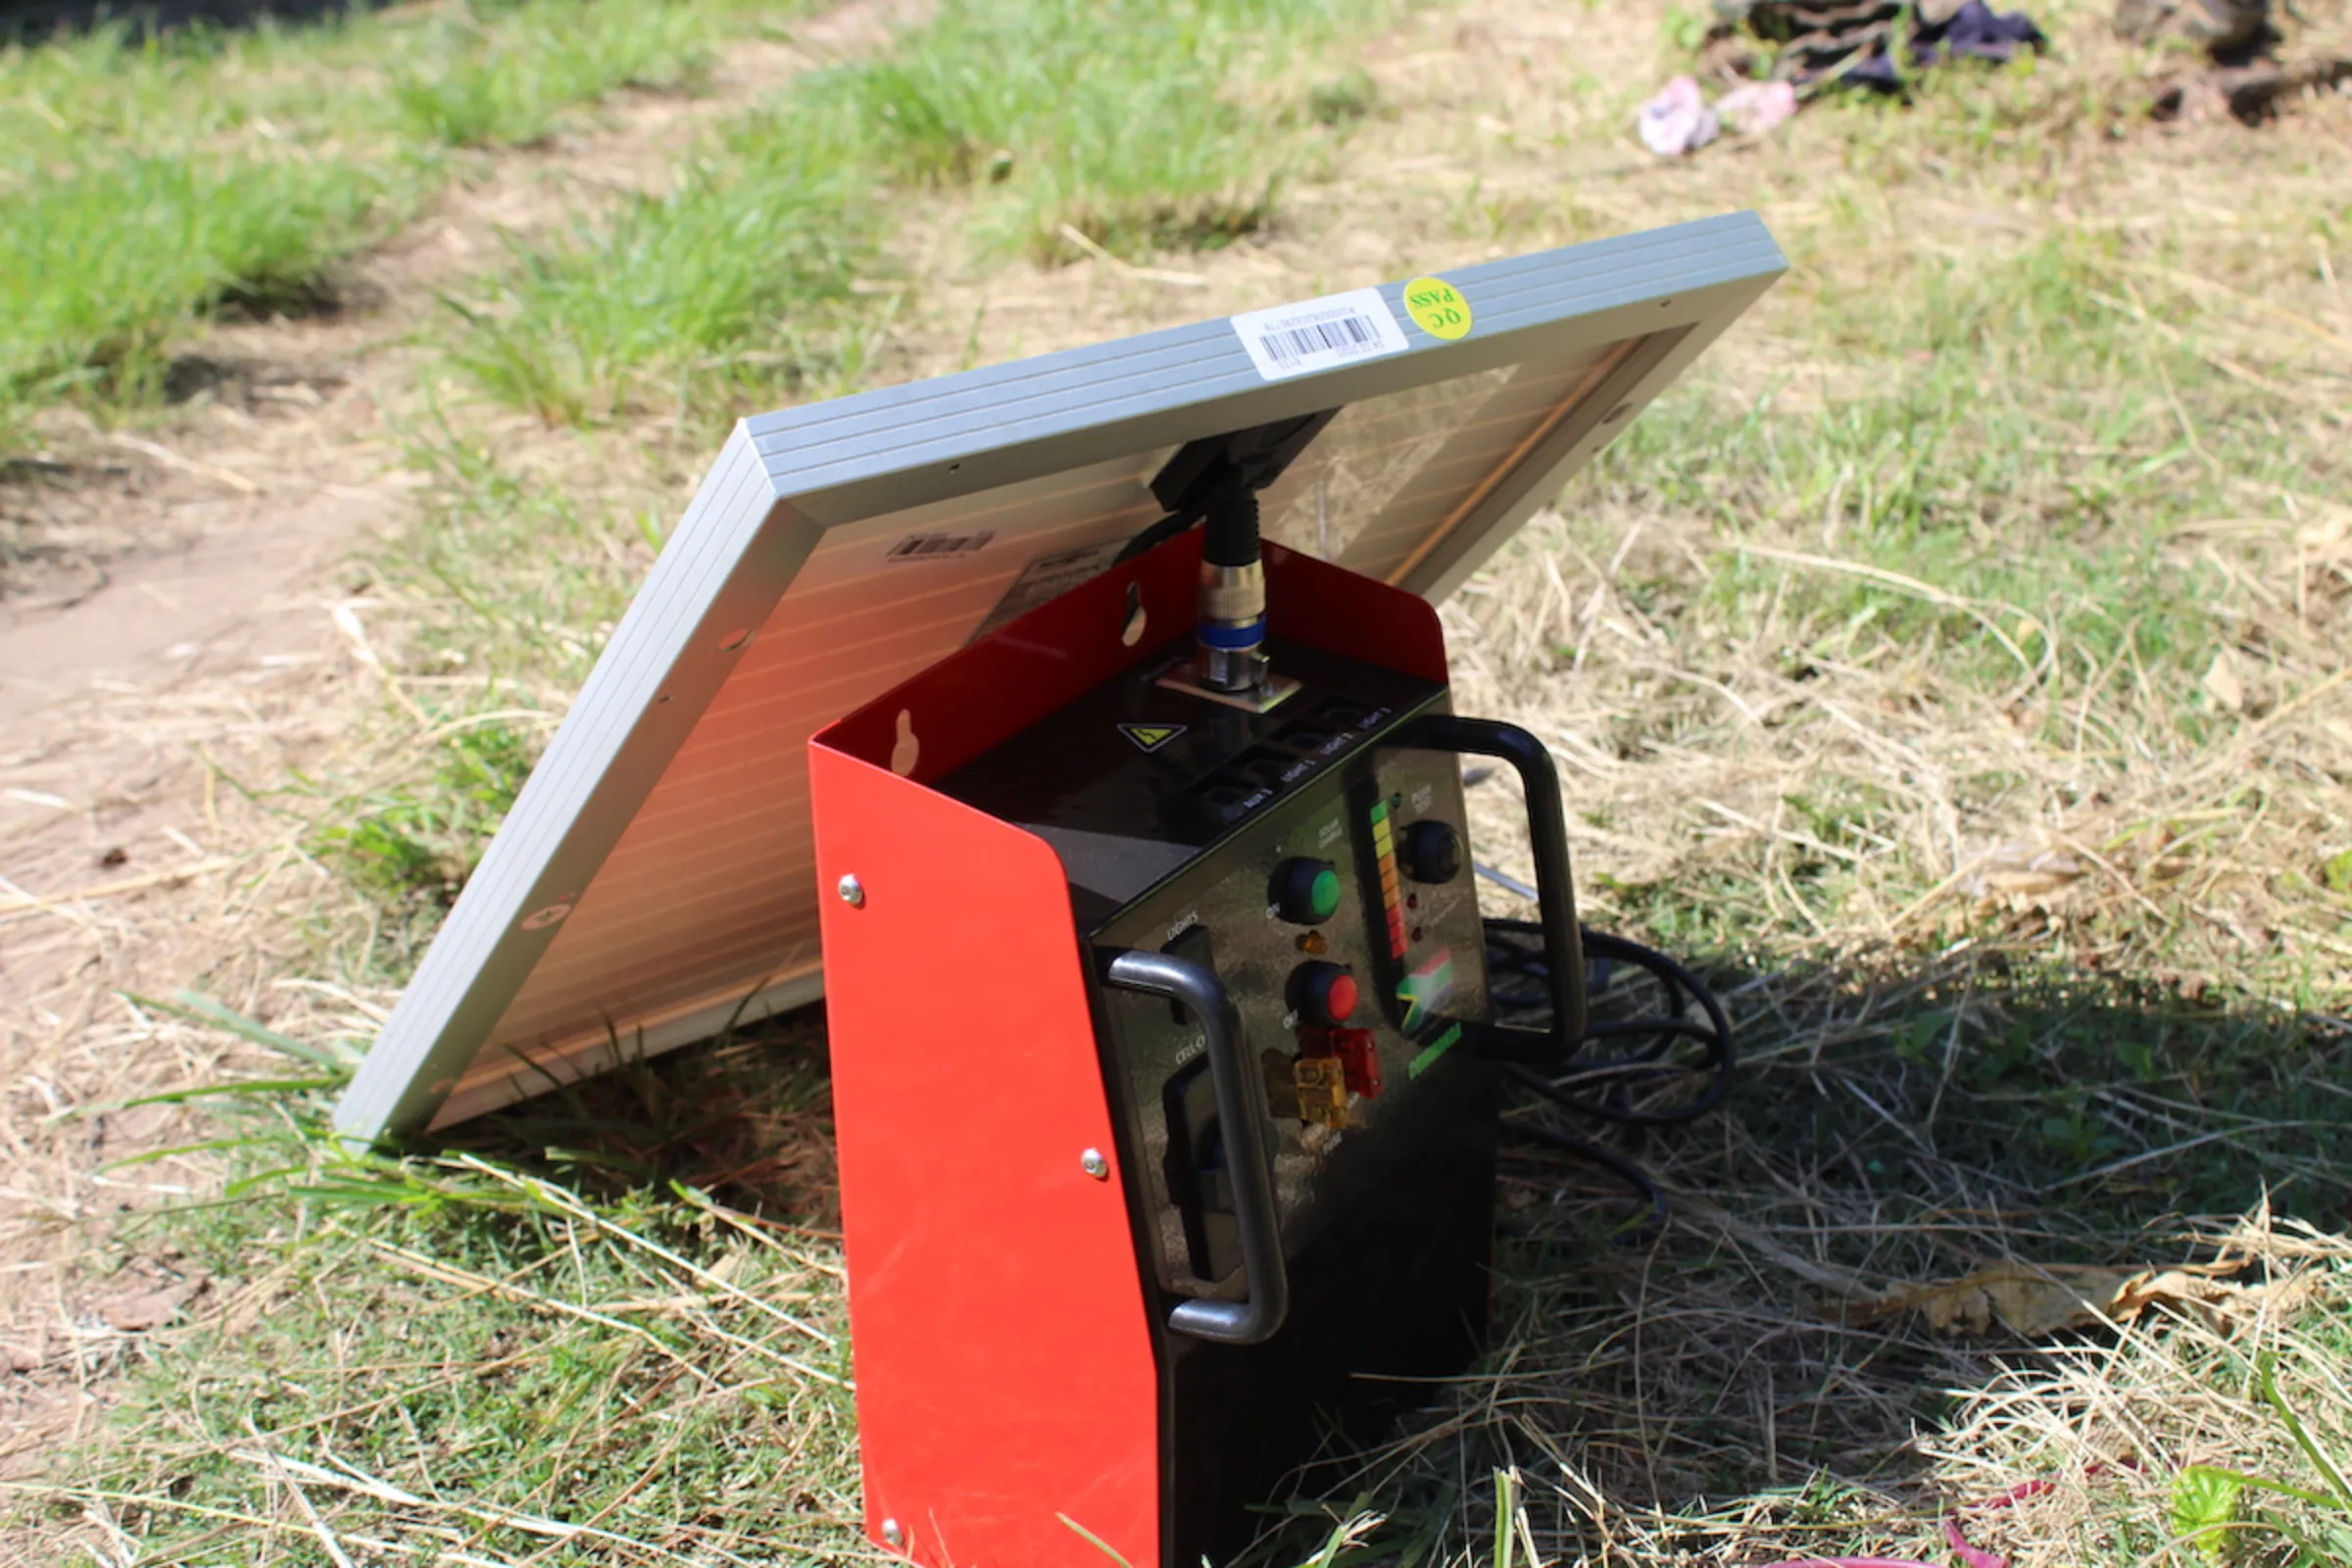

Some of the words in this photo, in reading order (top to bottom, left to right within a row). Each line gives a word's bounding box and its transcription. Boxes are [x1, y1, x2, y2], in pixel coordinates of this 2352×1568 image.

[1410, 287, 1456, 309] PASS
[1428, 307, 1461, 329] QC
[1167, 910, 1199, 941] LIGHTS
[1176, 1043, 1196, 1065] CELL
